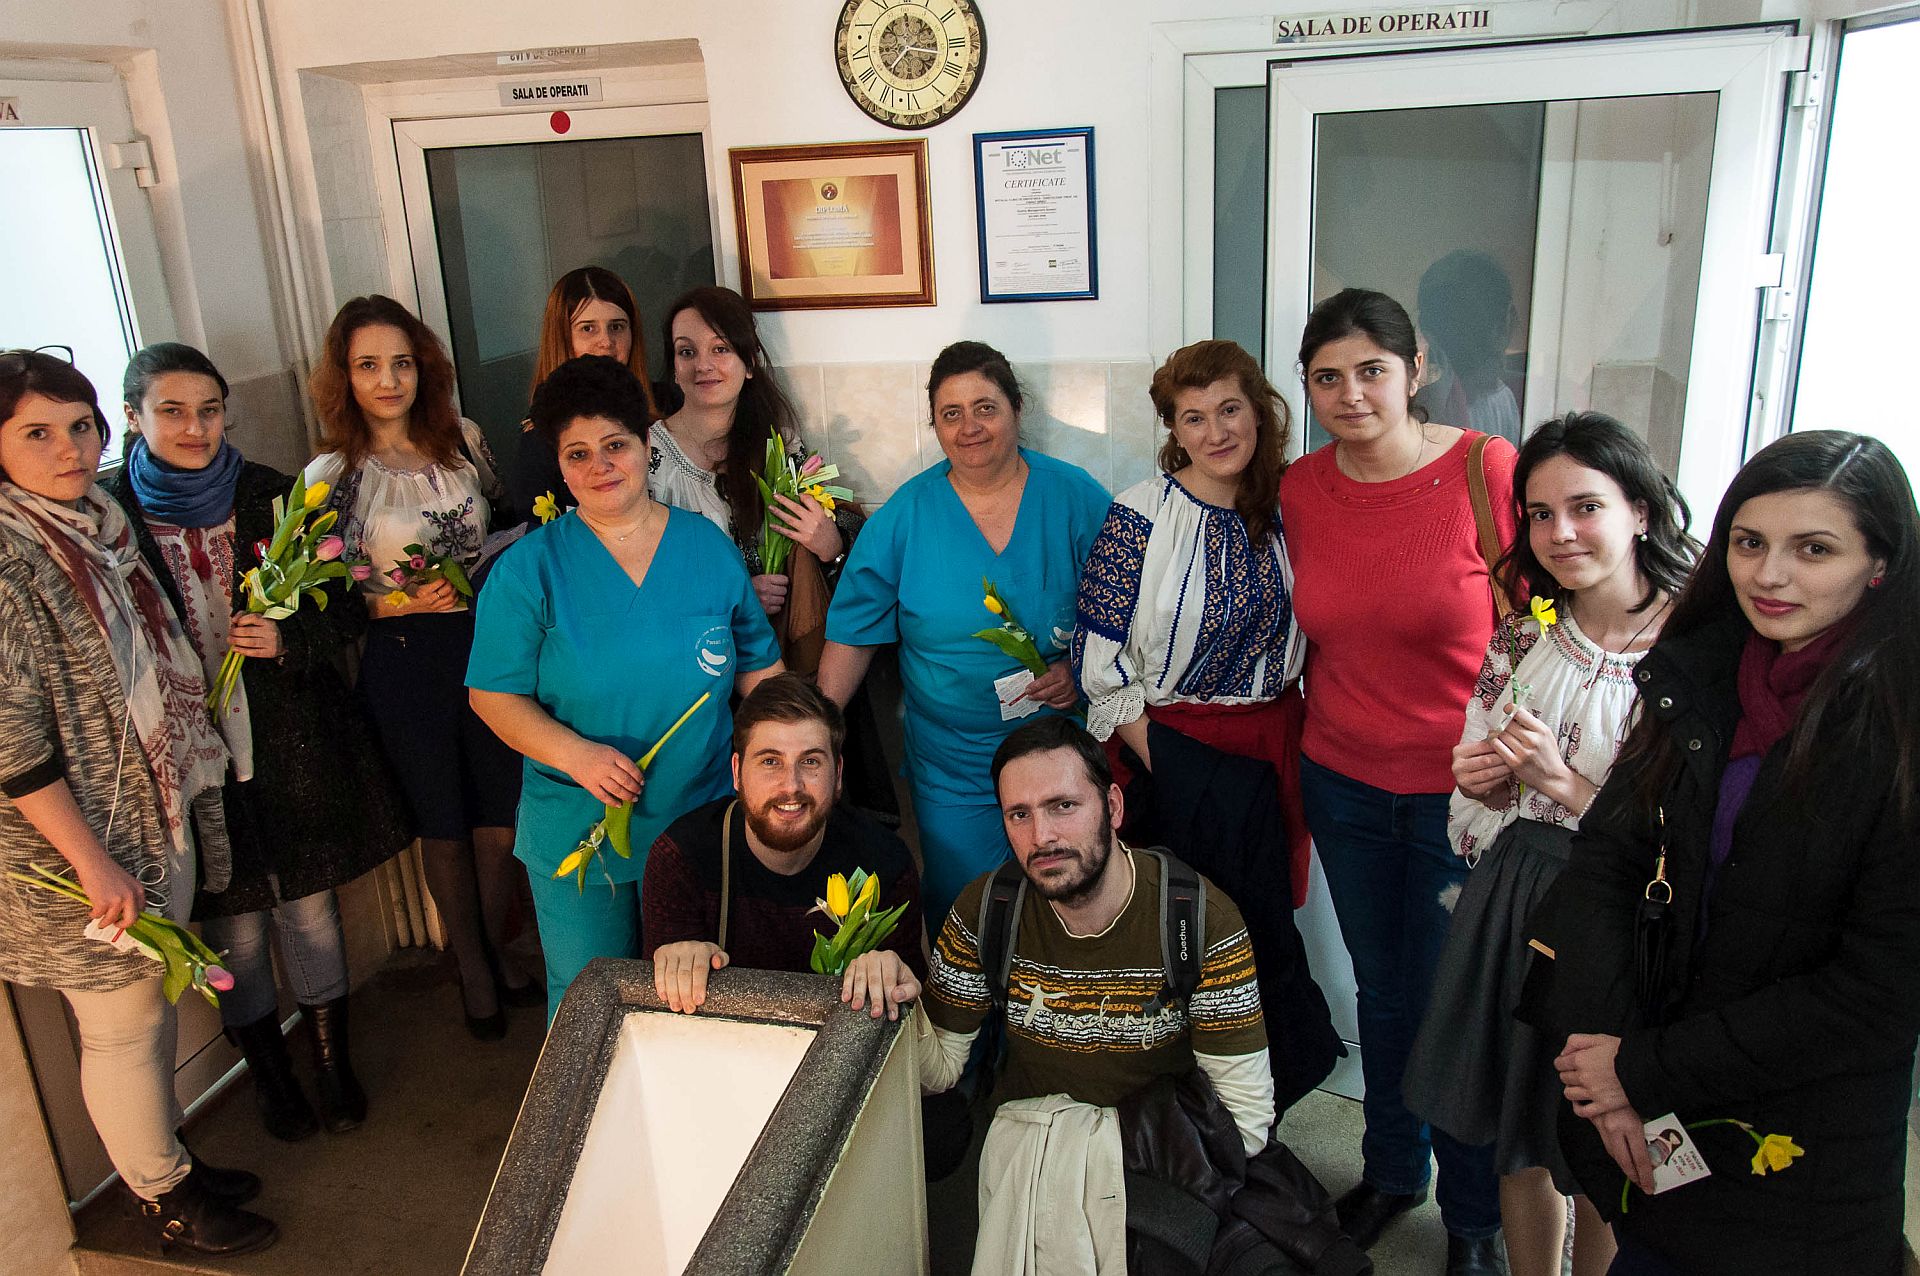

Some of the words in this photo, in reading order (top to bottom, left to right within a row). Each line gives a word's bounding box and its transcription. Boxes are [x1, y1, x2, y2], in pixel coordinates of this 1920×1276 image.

[1278, 19, 1336, 38] SALA
[1342, 16, 1372, 34] DE
[1378, 9, 1490, 32] OPERATII
[512, 87, 534, 100] SALA
[535, 86, 548, 98] DE
[549, 84, 589, 97] OPERATII
[1004, 177, 1067, 189] CERTIFICATE
[1179, 919, 1188, 961] Quechua
